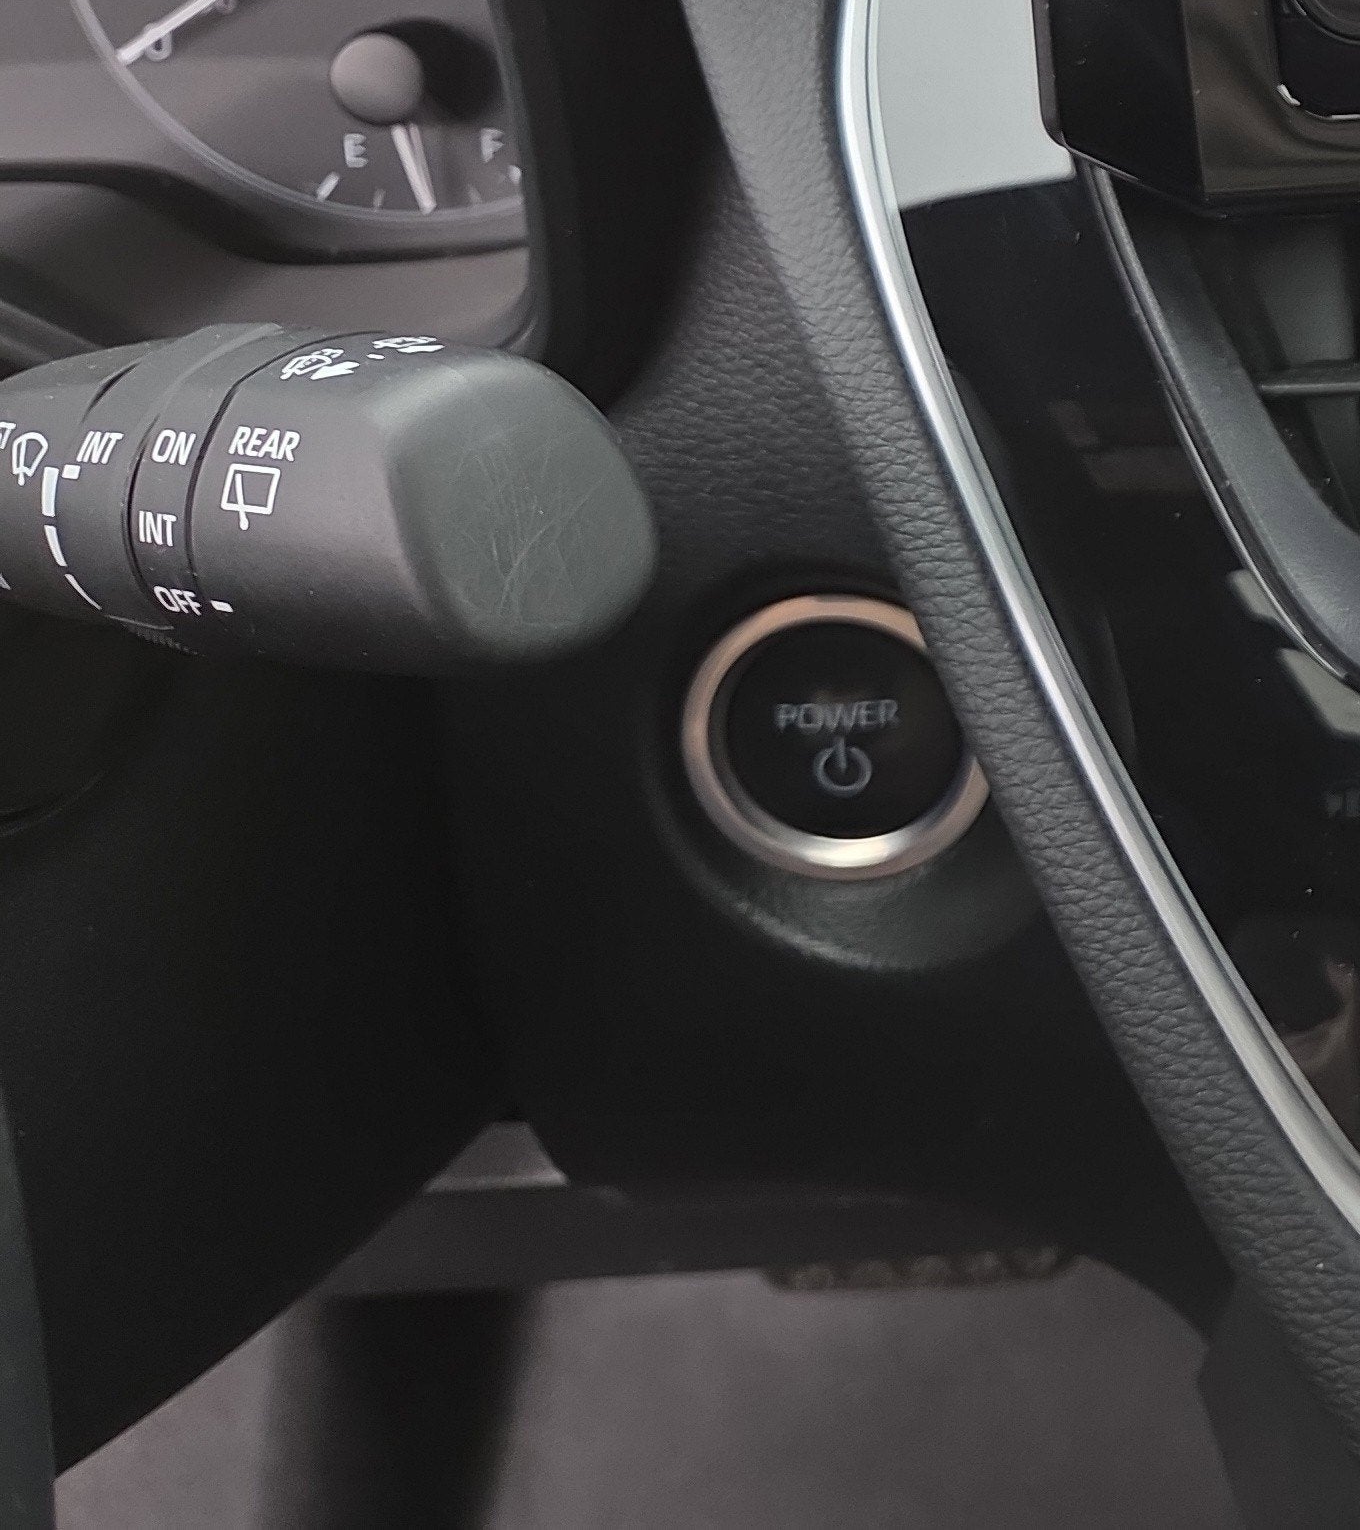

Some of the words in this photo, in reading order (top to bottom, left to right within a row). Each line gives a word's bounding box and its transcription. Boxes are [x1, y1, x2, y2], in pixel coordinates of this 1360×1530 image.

[343, 132, 369, 169] E
[77, 430, 124, 465] INT
[152, 429, 197, 466] ON
[228, 425, 302, 463] REAR
[138, 510, 177, 547] INT
[152, 585, 203, 617] OFF
[774, 699, 900, 734] POWER
